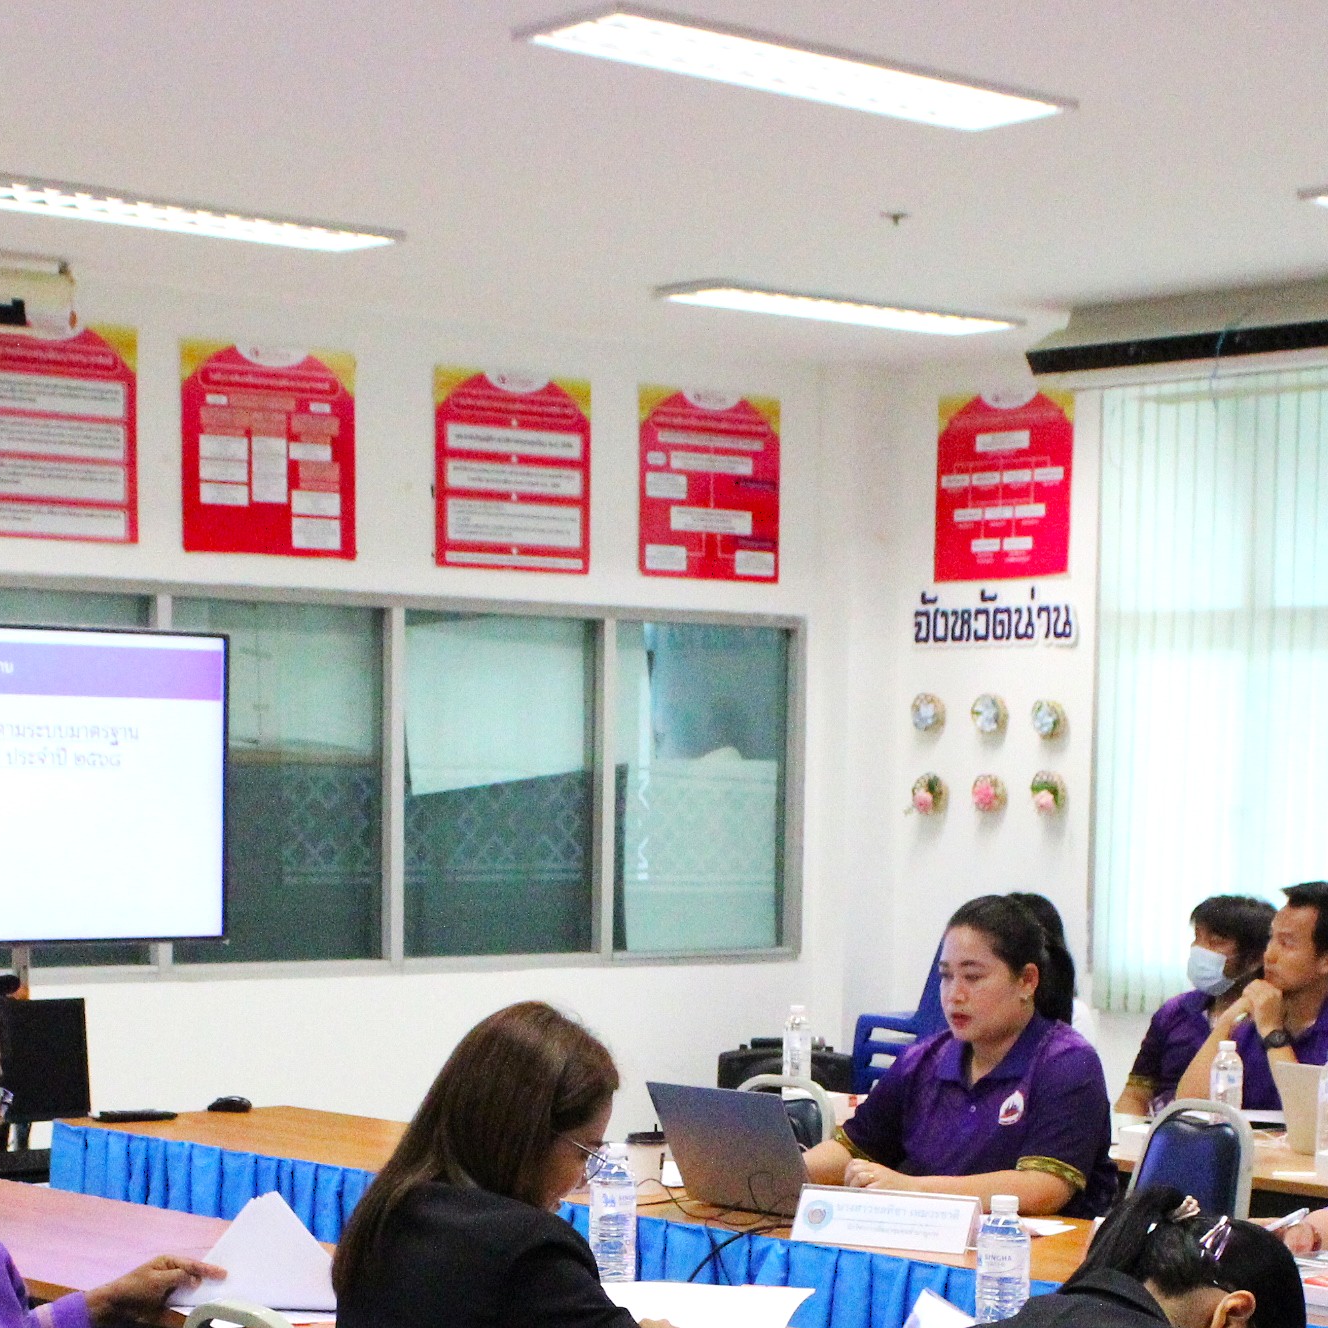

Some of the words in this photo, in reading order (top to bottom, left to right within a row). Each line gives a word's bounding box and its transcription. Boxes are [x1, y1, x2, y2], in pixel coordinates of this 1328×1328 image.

[914, 588, 1074, 643] จังหวัดน่าน
